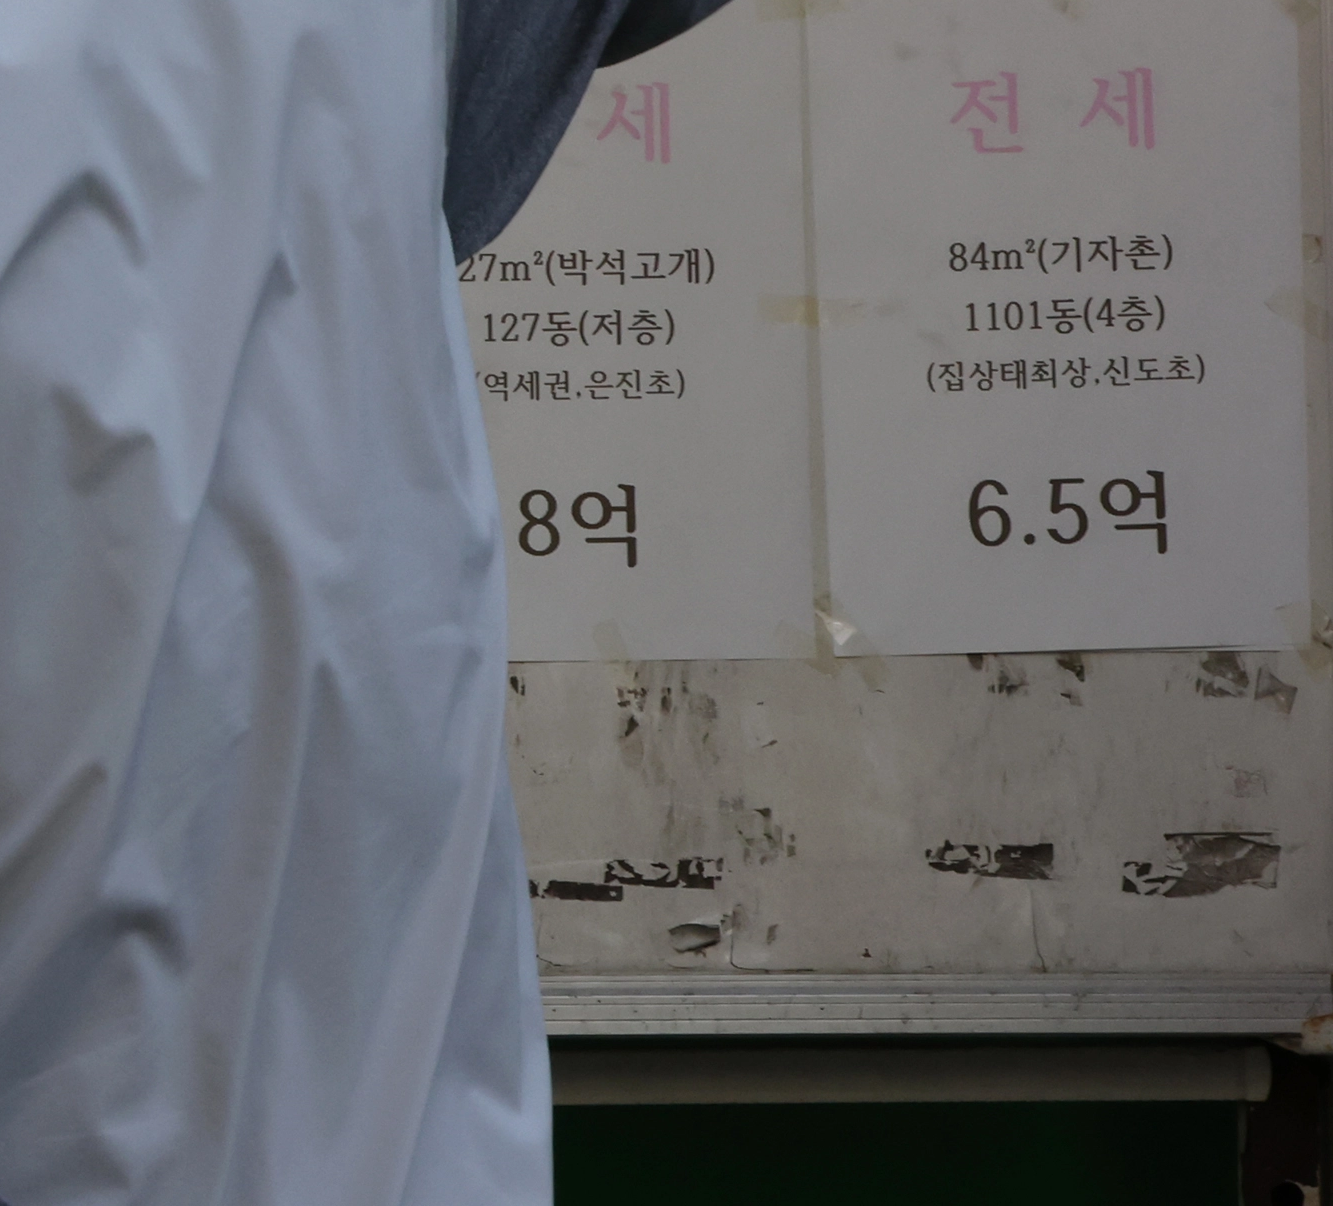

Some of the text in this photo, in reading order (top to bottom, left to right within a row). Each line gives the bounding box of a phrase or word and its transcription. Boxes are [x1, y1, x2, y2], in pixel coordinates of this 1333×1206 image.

[596, 81, 672, 165] 세
[951, 66, 1157, 155] 전 세
[459, 248, 715, 286] 27m²(박석고개)
[483, 308, 676, 348] 127동(저층)
[965, 294, 1166, 335] 1101동(4층)
[517, 483, 638, 569] 8억
[967, 469, 1169, 555] 6.5억
